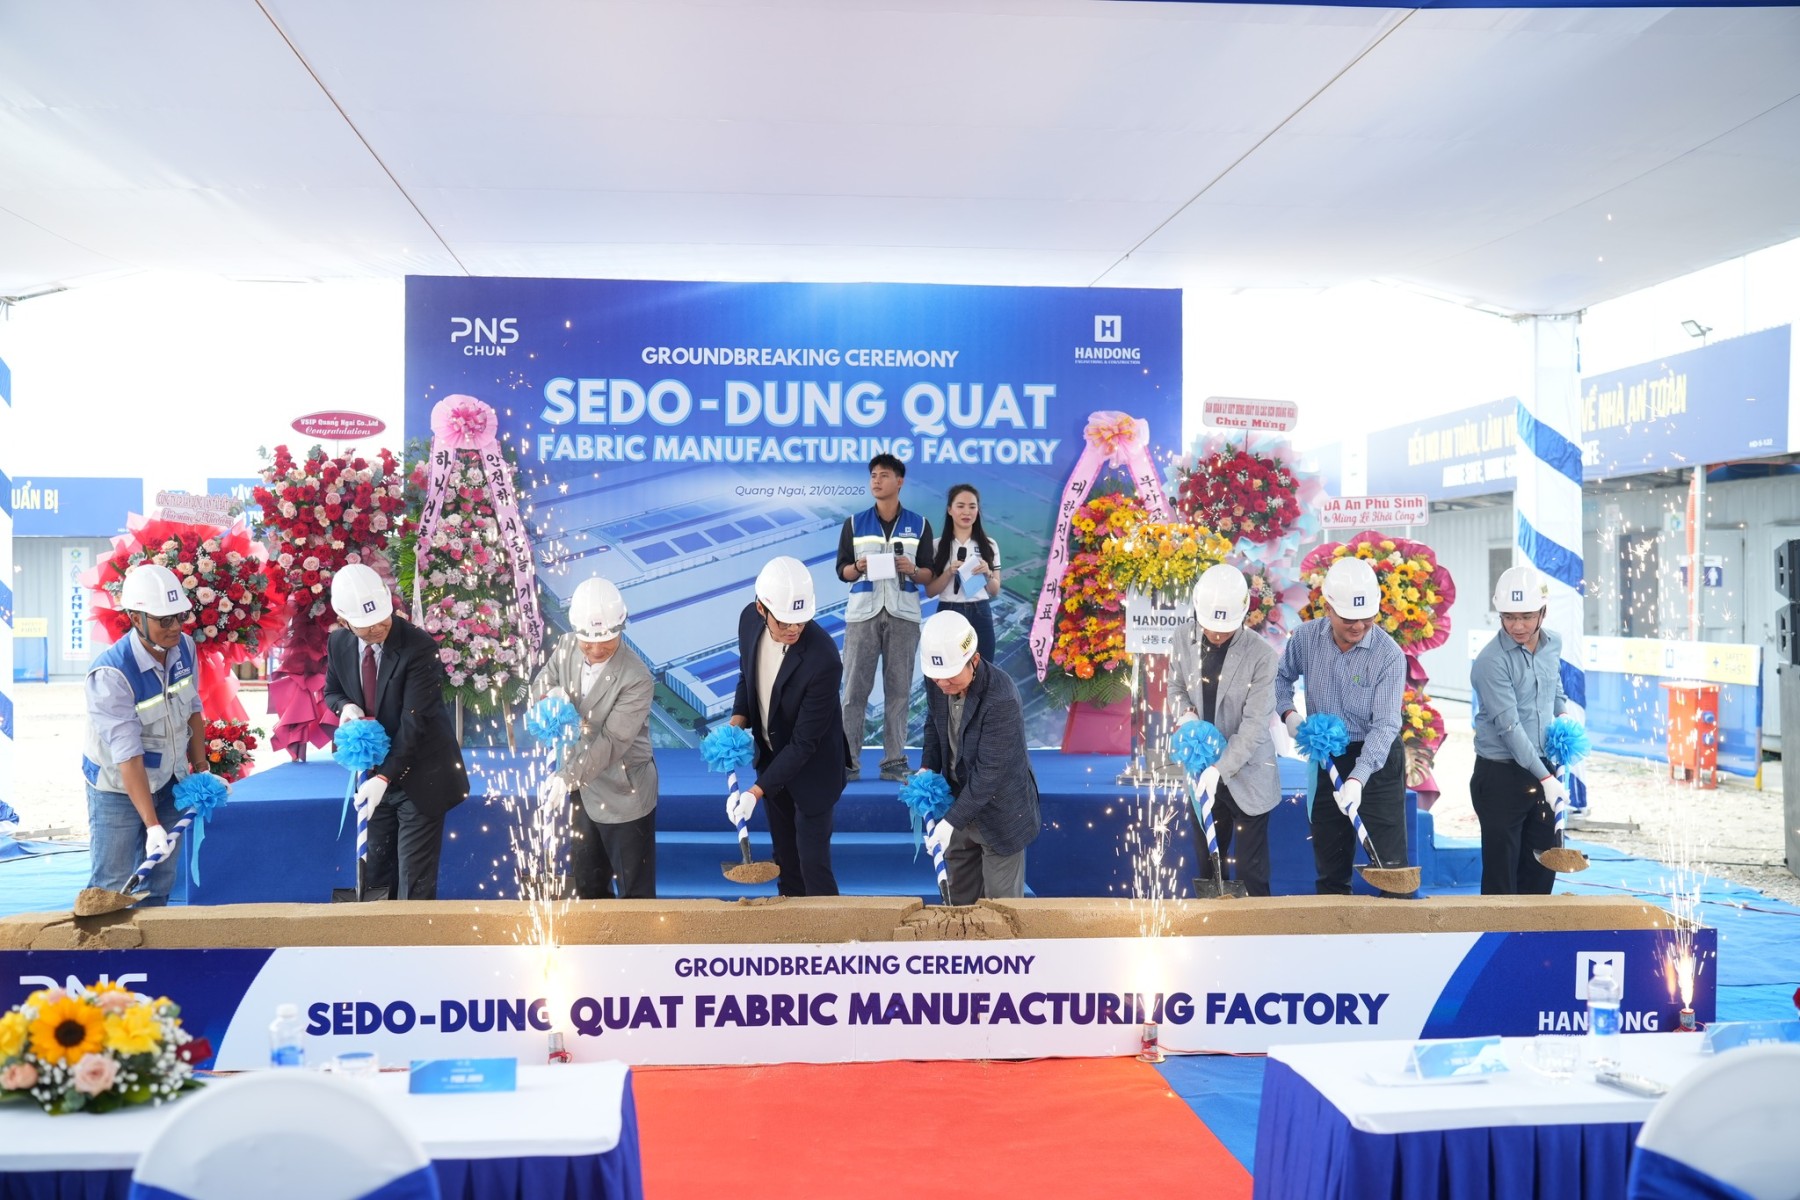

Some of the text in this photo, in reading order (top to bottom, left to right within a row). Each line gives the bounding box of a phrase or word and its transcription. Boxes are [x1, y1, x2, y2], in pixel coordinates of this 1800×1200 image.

[451, 317, 519, 344] PNS
[464, 345, 506, 356] CHUN
[641, 346, 959, 368] GROUNDBREAKING CEREMONY
[1074, 347, 1140, 359] HANDONG
[902, 381, 1057, 437] QUAT
[1599, 382, 1625, 429] NHÀ
[1627, 384, 1646, 423] AN
[305, 426, 371, 435] Congratulations
[1216, 416, 1247, 427] Chúc
[538, 433, 1061, 465] FABRIC MANUFACTURING FACTORY
[44, 488, 59, 514] BỊ
[735, 485, 866, 497] Quang Ngai, 21/01/2026
[1345, 500, 1361, 510] An
[1394, 497, 1423, 508] Sinh
[1053, 480, 1087, 564] 대한전기
[1039, 579, 1058, 620] 대표
[674, 955, 1036, 977] GROUNDBREAKING CEREMONY
[570, 996, 684, 1037] QUAT
[695, 993, 839, 1028] FABRIC
[848, 992, 1195, 1026] MANUFACTURING
[1206, 992, 1390, 1026] FACTORY
